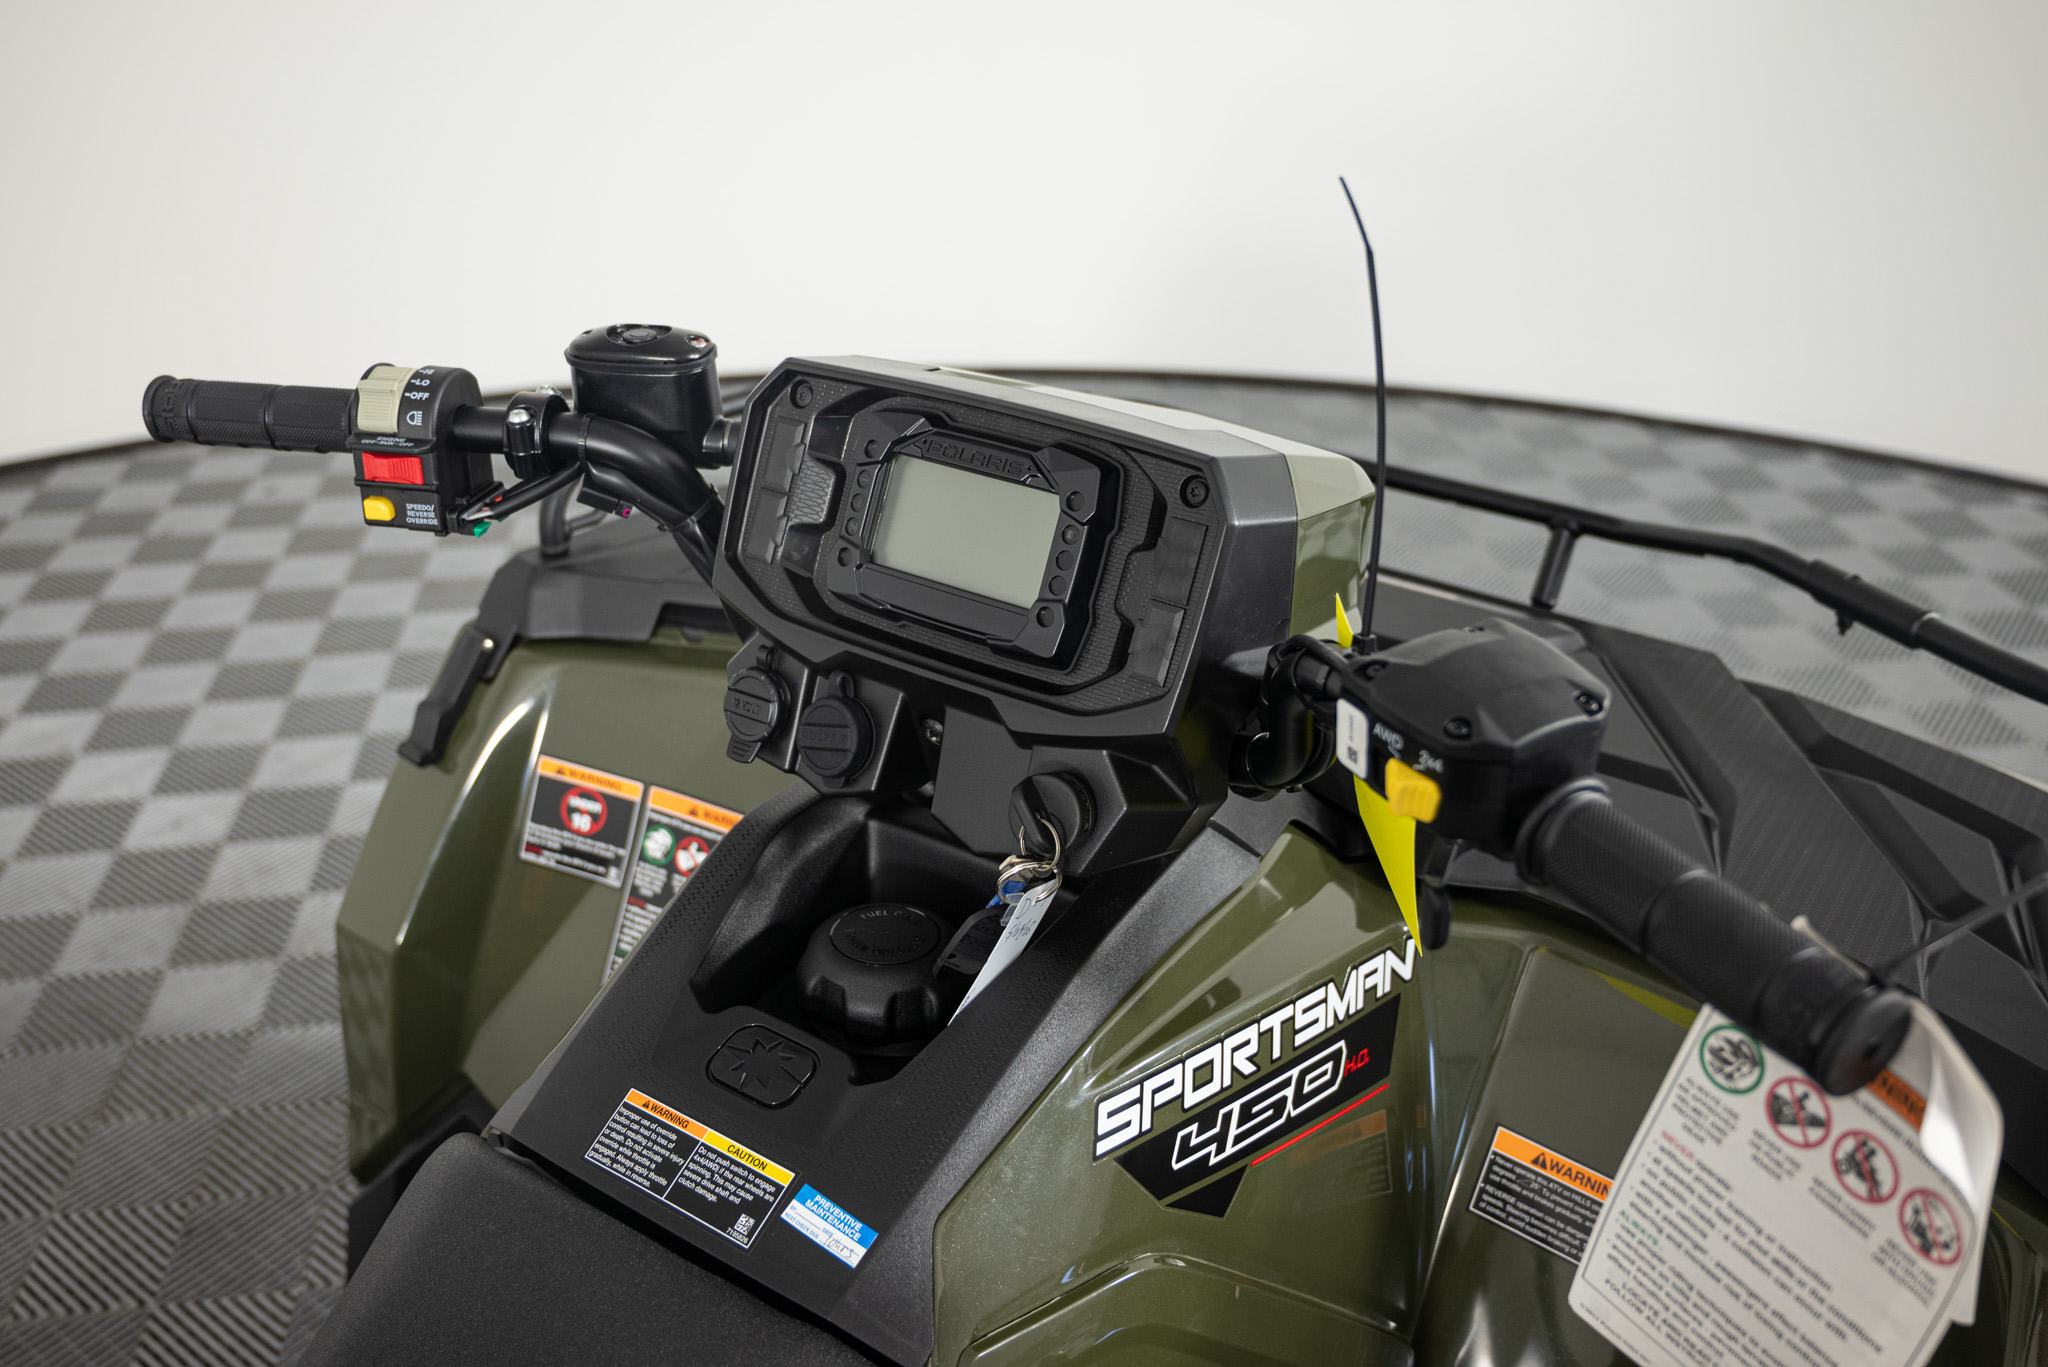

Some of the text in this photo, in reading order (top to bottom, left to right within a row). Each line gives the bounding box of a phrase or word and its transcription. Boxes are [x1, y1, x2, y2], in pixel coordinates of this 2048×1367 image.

[410, 392, 430, 400] OFF
[926, 439, 1025, 476] POLARIS
[406, 503, 435, 511] SPEEDO/
[406, 517, 439, 526] OVERRIDE
[1372, 722, 1404, 751] AWD
[571, 812, 592, 832] 16
[860, 910, 889, 920] FUEL
[1096, 938, 1416, 1156] SPORTSMAN
[650, 1104, 689, 1128] WARNING
[1171, 1039, 1347, 1171] 450
[1344, 1048, 1370, 1077] H.O.
[614, 1113, 631, 1125] button
[639, 1127, 652, 1136] lead
[656, 1136, 668, 1145] loss
[618, 1106, 641, 1122] Improper
[656, 1126, 677, 1140] override
[599, 1135, 619, 1149] override
[618, 1146, 633, 1156] while
[631, 1153, 651, 1166] throttle
[609, 1120, 627, 1133] control
[625, 1129, 648, 1145] resulting
[652, 1145, 669, 1156] severe
[668, 1153, 685, 1166] injury
[610, 1131, 626, 1142] death.
[625, 1139, 634, 1147] Do
[633, 1143, 643, 1151] not
[642, 1148, 663, 1162] activate
[727, 1145, 767, 1170] CAUTION
[588, 1149, 613, 1167] gradually,
[612, 1162, 627, 1173] while
[631, 1174, 651, 1187] reverse.
[593, 1142, 667, 1185] engaged. Always apply throttle
[692, 1154, 720, 1172] 4x4(AWD)
[723, 1170, 733, 1179] the
[733, 1177, 744, 1185] rear
[744, 1182, 765, 1196] wheels
[698, 1147, 775, 1194] Do not push switch to engage
[1548, 1159, 1608, 1197] WARNIN
[678, 1177, 719, 1203] clutch damage.
[683, 1170, 741, 1203] severe drive shaft and
[687, 1162, 753, 1200] spinning. This may cause
[785, 1213, 819, 1238] NEXT CHECK DUE
[805, 1199, 861, 1241] MAINTENANCE
[814, 1195, 862, 1231] PREVENTIVE
[726, 1228, 748, 1244] 7195826
